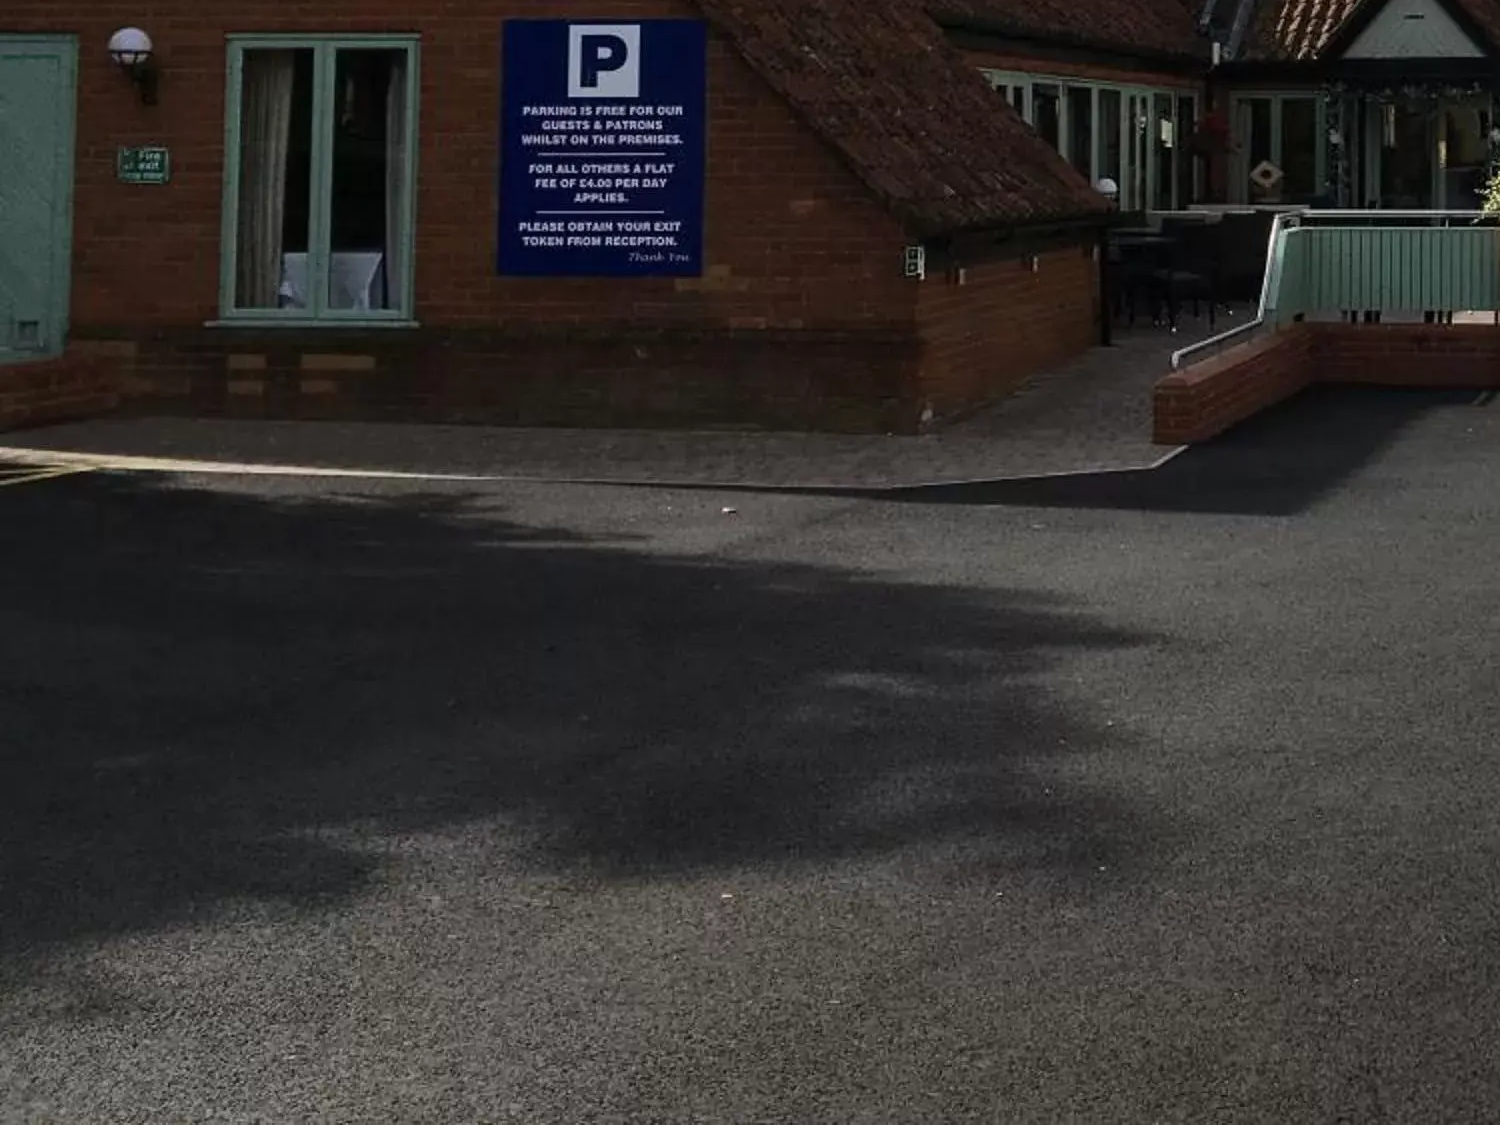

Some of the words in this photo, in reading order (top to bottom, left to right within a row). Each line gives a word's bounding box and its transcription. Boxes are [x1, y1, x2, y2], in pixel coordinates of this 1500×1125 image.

[580, 35, 628, 88] P
[523, 106, 577, 116] PARKING
[580, 106, 592, 116] IS
[595, 106, 626, 116] FREE
[629, 106, 653, 116] FOR
[657, 106, 683, 116] OUR
[542, 120, 590, 130] GUESTS
[593, 120, 602, 130] &
[605, 120, 663, 130] PATRONS
[521, 134, 567, 145] WHILST
[570, 134, 588, 145] ON
[592, 134, 615, 145] THE
[619, 134, 684, 145] PREMISES.
[528, 164, 553, 174] FOR
[556, 164, 579, 174] ALL
[581, 164, 631, 174] OTHERS
[633, 164, 641, 174] A
[645, 164, 675, 174] FLAT
[535, 178, 557, 188] FEE
[560, 178, 575, 188] OF
[579, 178, 613, 188] £4.00
[615, 178, 639, 188] PER
[642, 178, 667, 188] DAY
[573, 193, 629, 203] APPLIES.
[519, 222, 565, 232] PLEASE
[567, 222, 613, 232] OBTAIN
[616, 222, 651, 232] YOUR
[654, 222, 681, 232] EXIT
[521, 236, 564, 246] TOKEN
[567, 236, 601, 246] FROM
[605, 236, 678, 246] RECEPTION.
[627, 252, 665, 263] Thank
[669, 252, 690, 263] You
